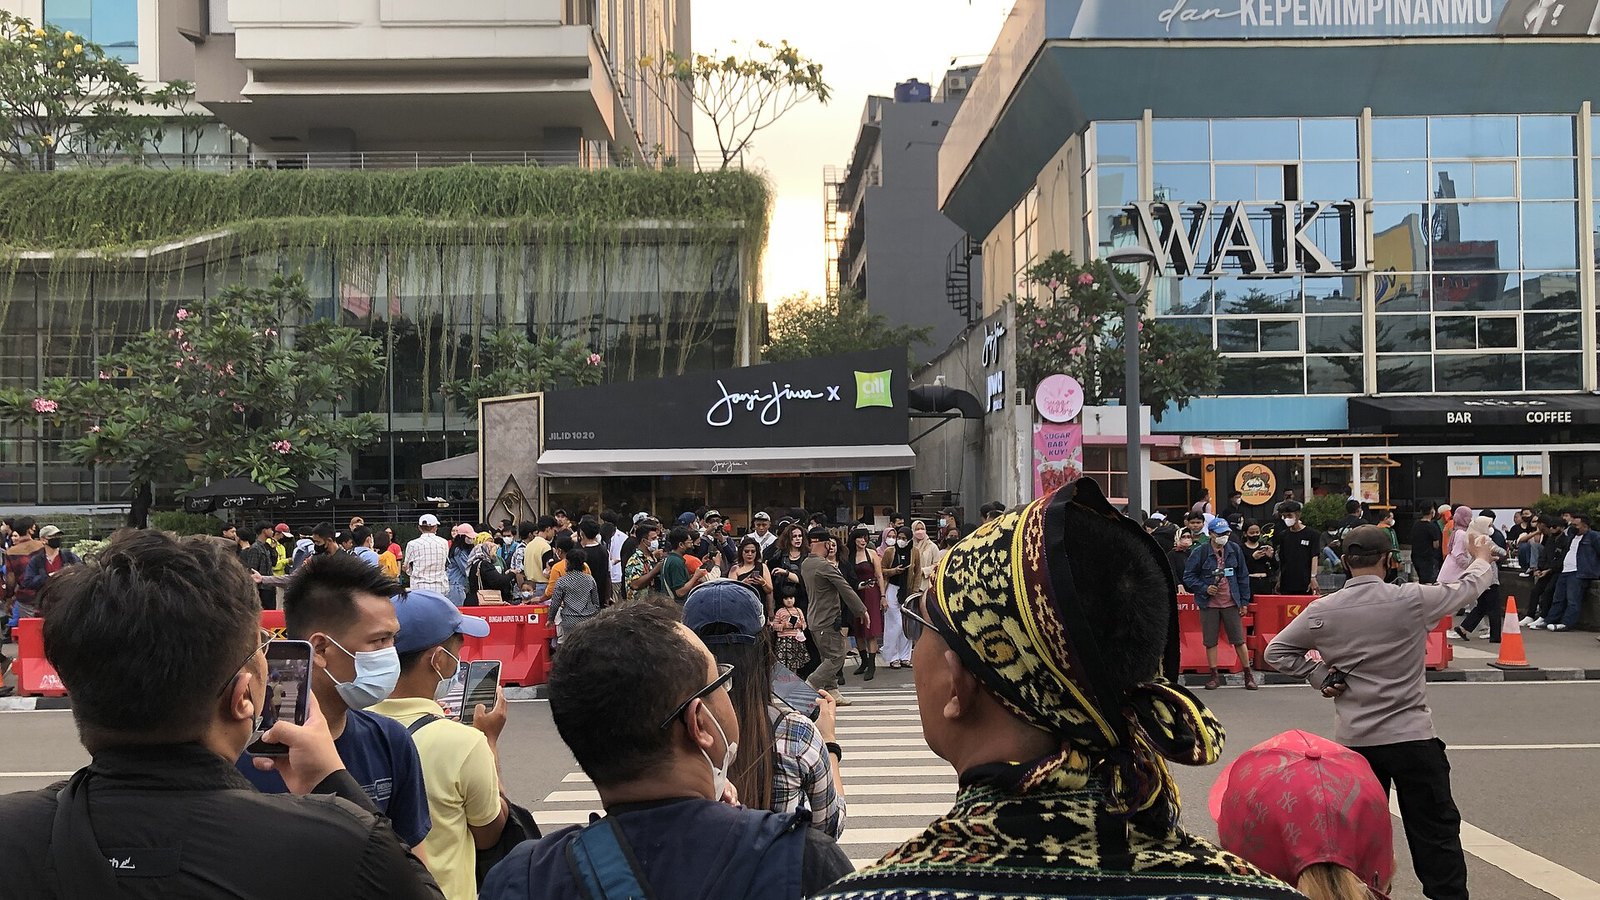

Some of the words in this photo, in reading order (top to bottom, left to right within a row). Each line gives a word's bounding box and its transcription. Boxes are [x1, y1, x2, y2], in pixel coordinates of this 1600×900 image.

[1158, 0, 1242, 35] dan
[1240, 0, 1492, 26] KEPEMIMPINANMU
[1130, 198, 1373, 276] WAKI
[1446, 411, 1472, 424] BAR
[1526, 411, 1572, 423] COFFEE
[1044, 432, 1071, 440] SUGAR
[1047, 440, 1069, 448] BABY
[1048, 448, 1068, 456] KUY!
